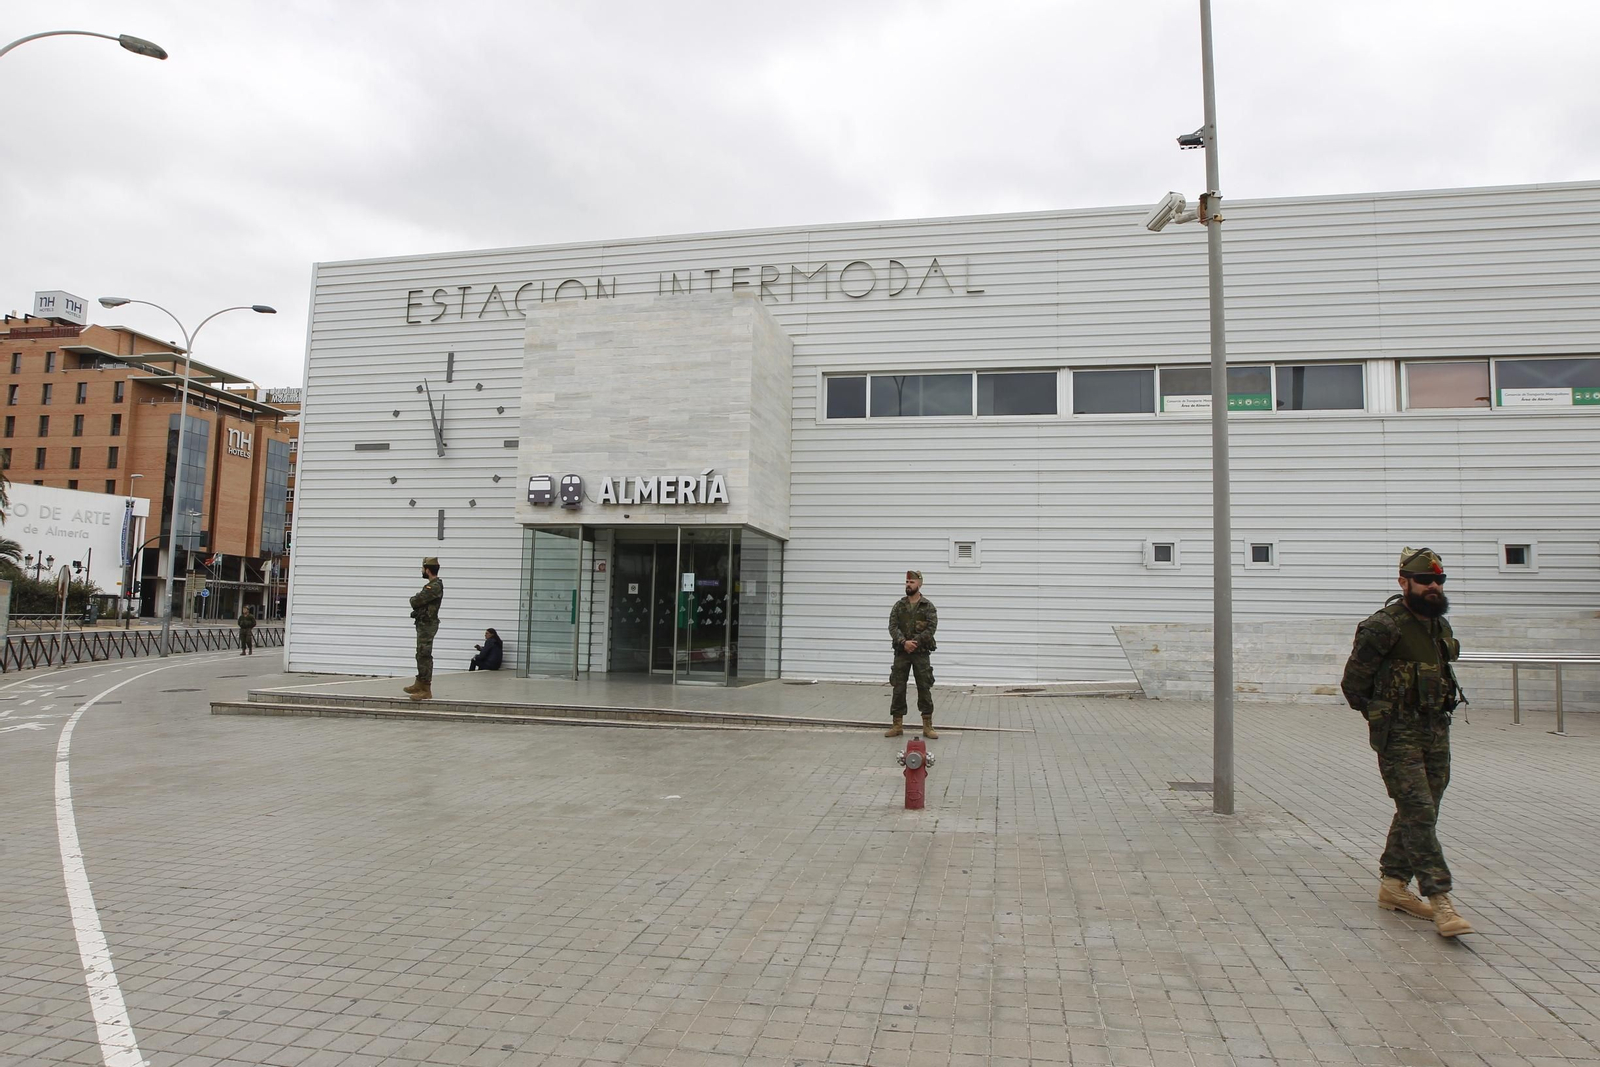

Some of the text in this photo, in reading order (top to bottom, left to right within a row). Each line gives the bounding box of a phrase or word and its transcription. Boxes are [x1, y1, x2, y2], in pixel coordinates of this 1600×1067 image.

[406, 257, 983, 324] ESTACION INTERMODAL
[65, 310, 81, 318] HOTELS
[228, 447, 251, 459] HOTELS
[597, 468, 730, 505] ALMERÍA
[39, 505, 62, 521] DE
[71, 509, 111, 526] ARTE
[23, 524, 90, 539] de Almería
